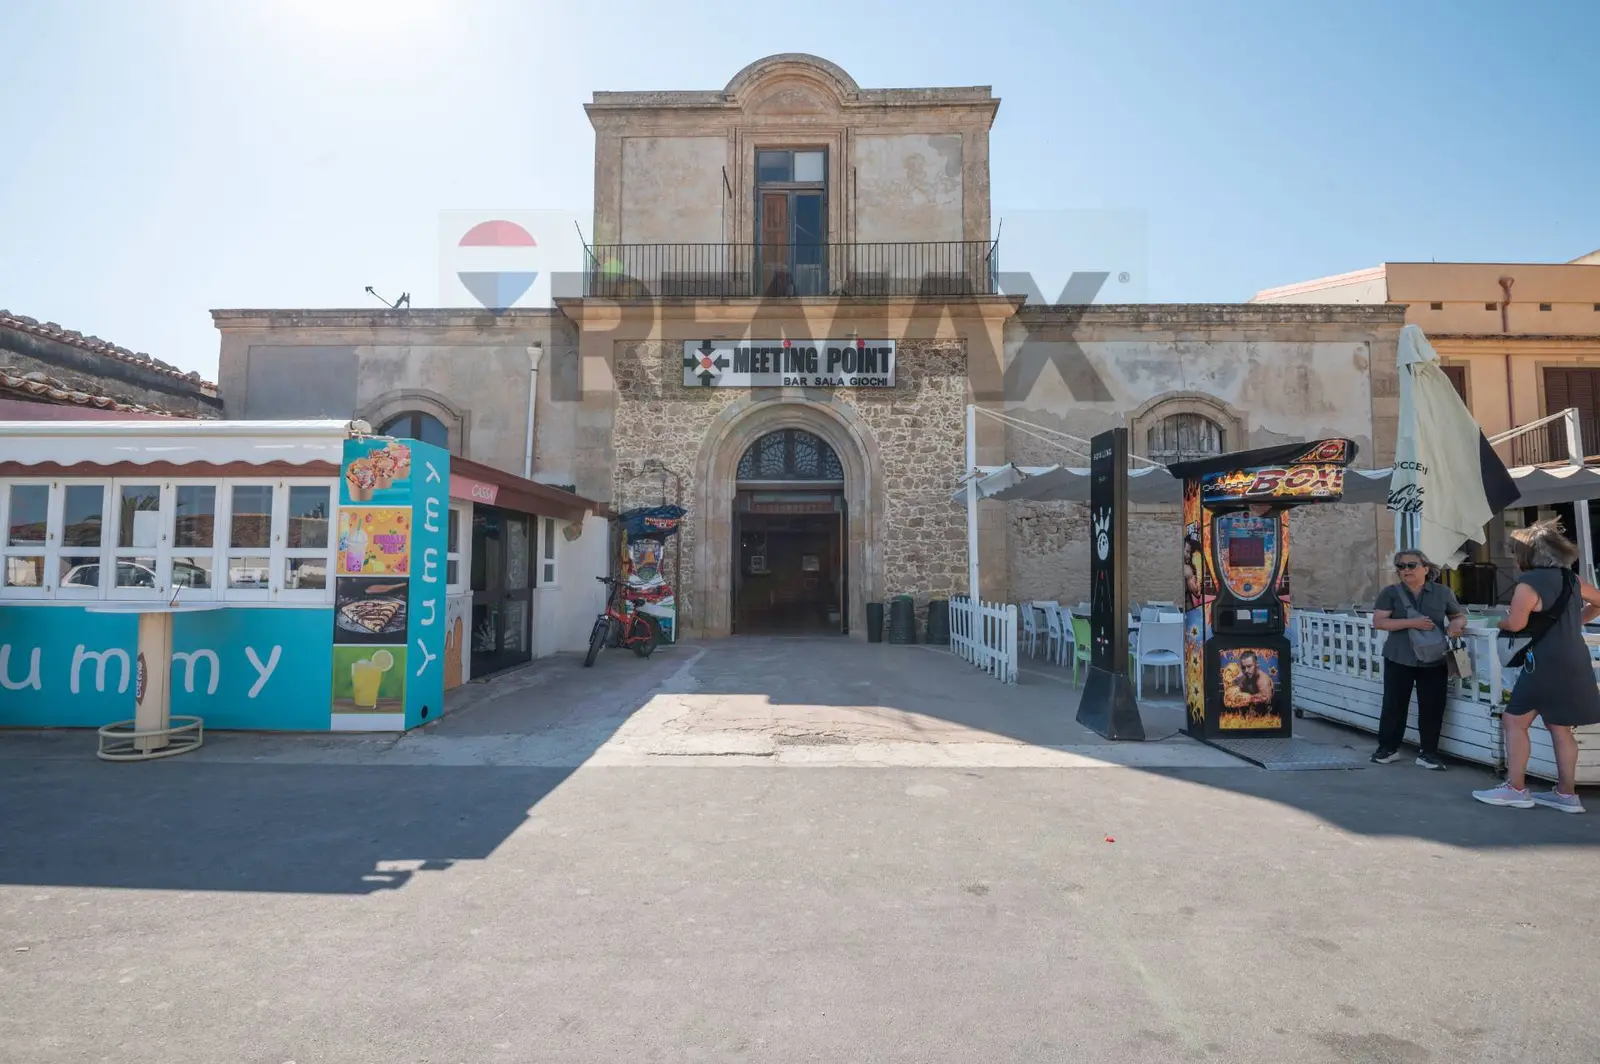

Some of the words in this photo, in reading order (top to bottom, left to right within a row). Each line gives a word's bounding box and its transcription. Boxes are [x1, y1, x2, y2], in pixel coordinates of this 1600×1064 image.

[733, 340, 818, 373] MEETING
[827, 340, 892, 373] POINT
[784, 377, 807, 386] BAR
[814, 377, 845, 386] SALA
[850, 377, 888, 386] GIOCHI
[472, 484, 495, 502] CASSA
